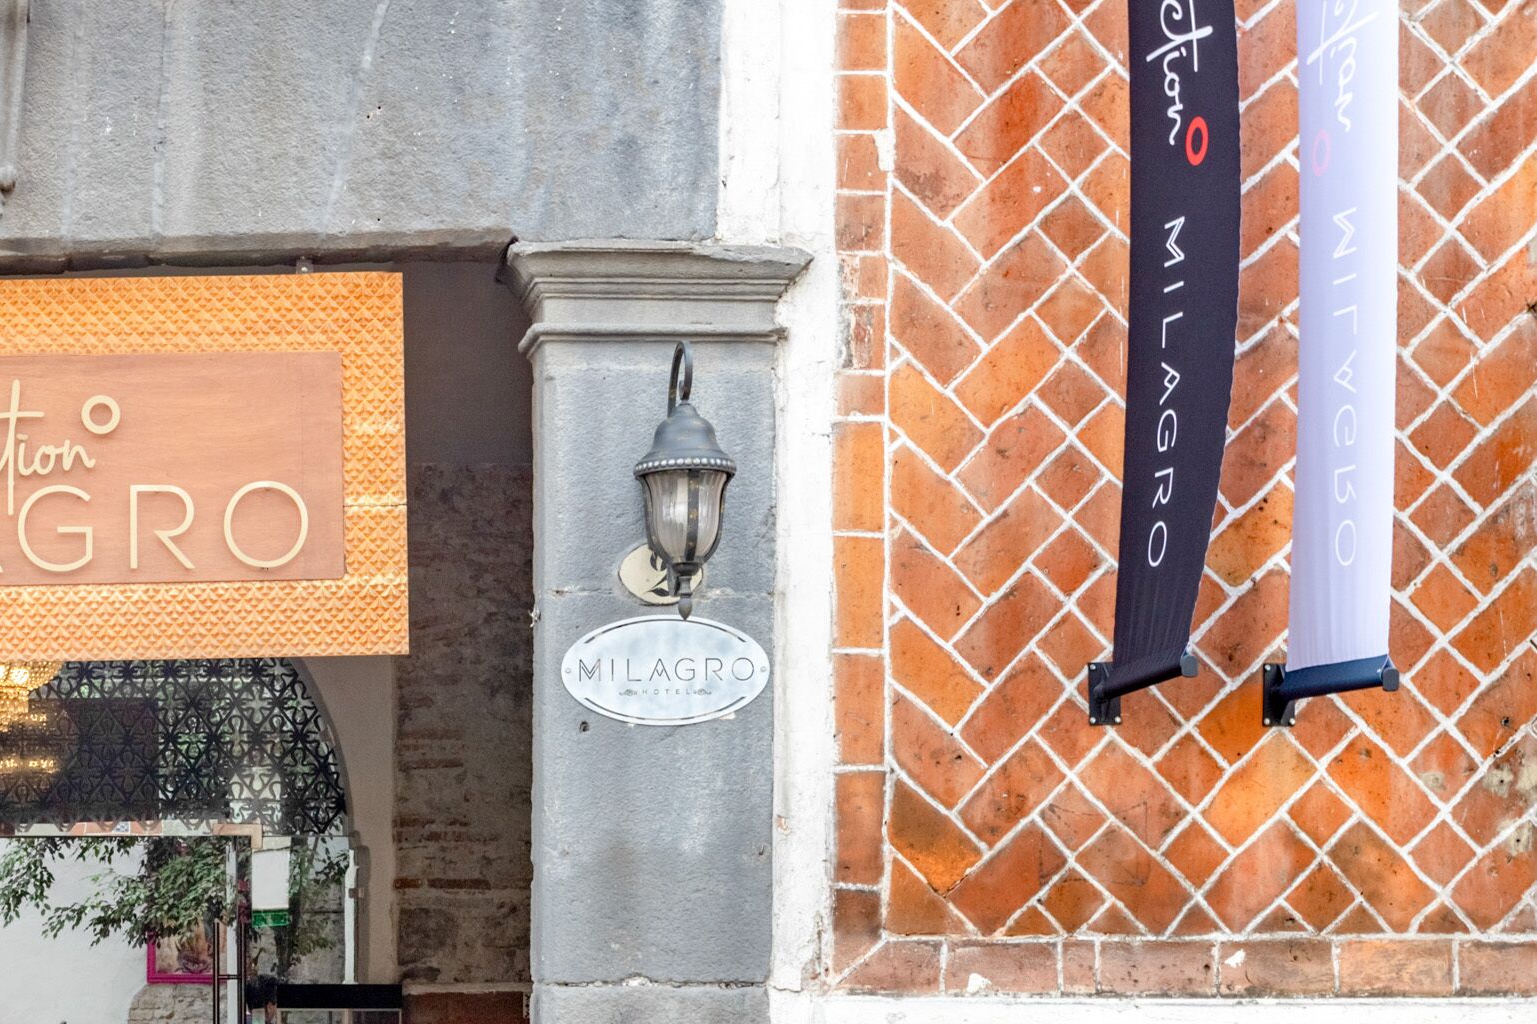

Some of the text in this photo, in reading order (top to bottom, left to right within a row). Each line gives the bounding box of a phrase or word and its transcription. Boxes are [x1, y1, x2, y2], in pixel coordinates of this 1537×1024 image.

[1147, 215, 1186, 567] MILAGRO
[578, 657, 755, 682] MILAGRO
[642, 688, 691, 696] HOTEL
